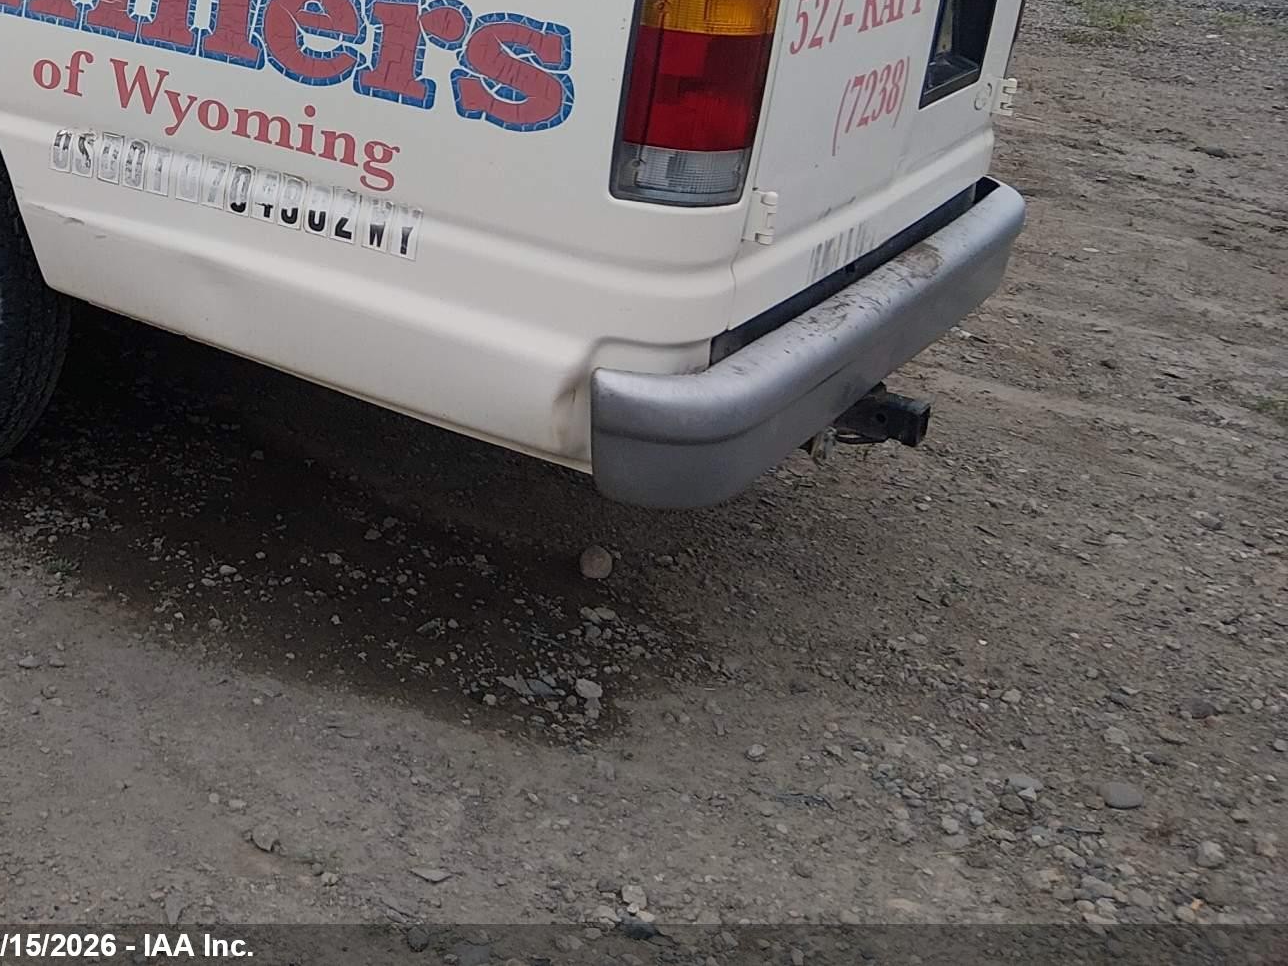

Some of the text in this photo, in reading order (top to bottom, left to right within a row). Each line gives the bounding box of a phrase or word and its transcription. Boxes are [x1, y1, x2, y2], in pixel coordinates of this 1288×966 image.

[32, 49, 401, 192] of Wyoming
[831, 56, 911, 157] (7238)
